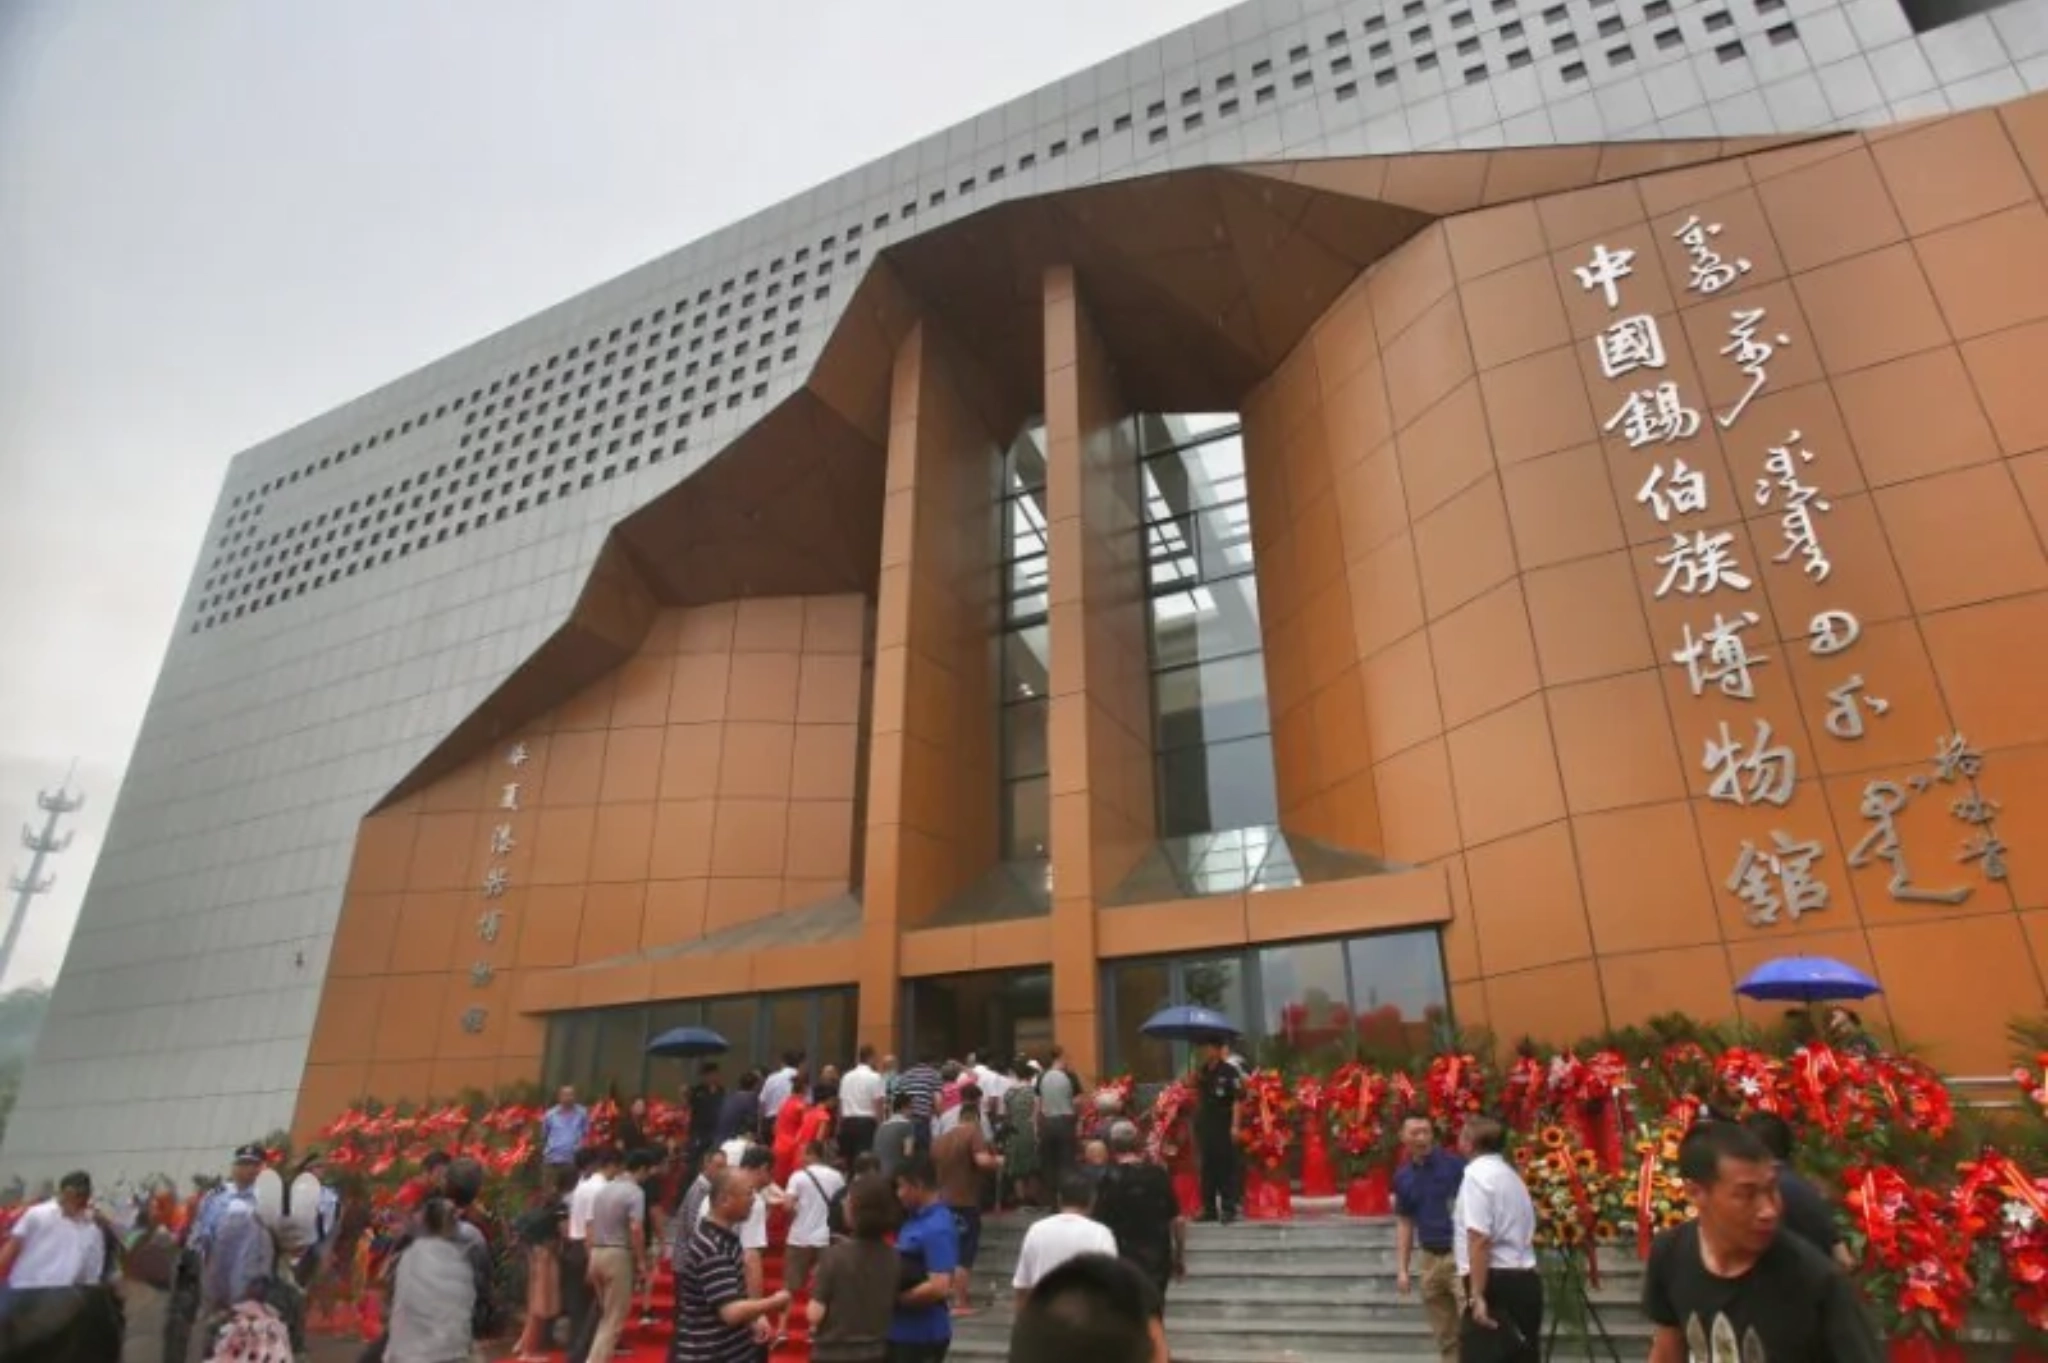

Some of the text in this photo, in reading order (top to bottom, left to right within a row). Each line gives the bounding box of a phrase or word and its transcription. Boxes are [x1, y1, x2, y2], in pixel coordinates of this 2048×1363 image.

[1573, 244, 1829, 926] 中國錫伯族博物館
